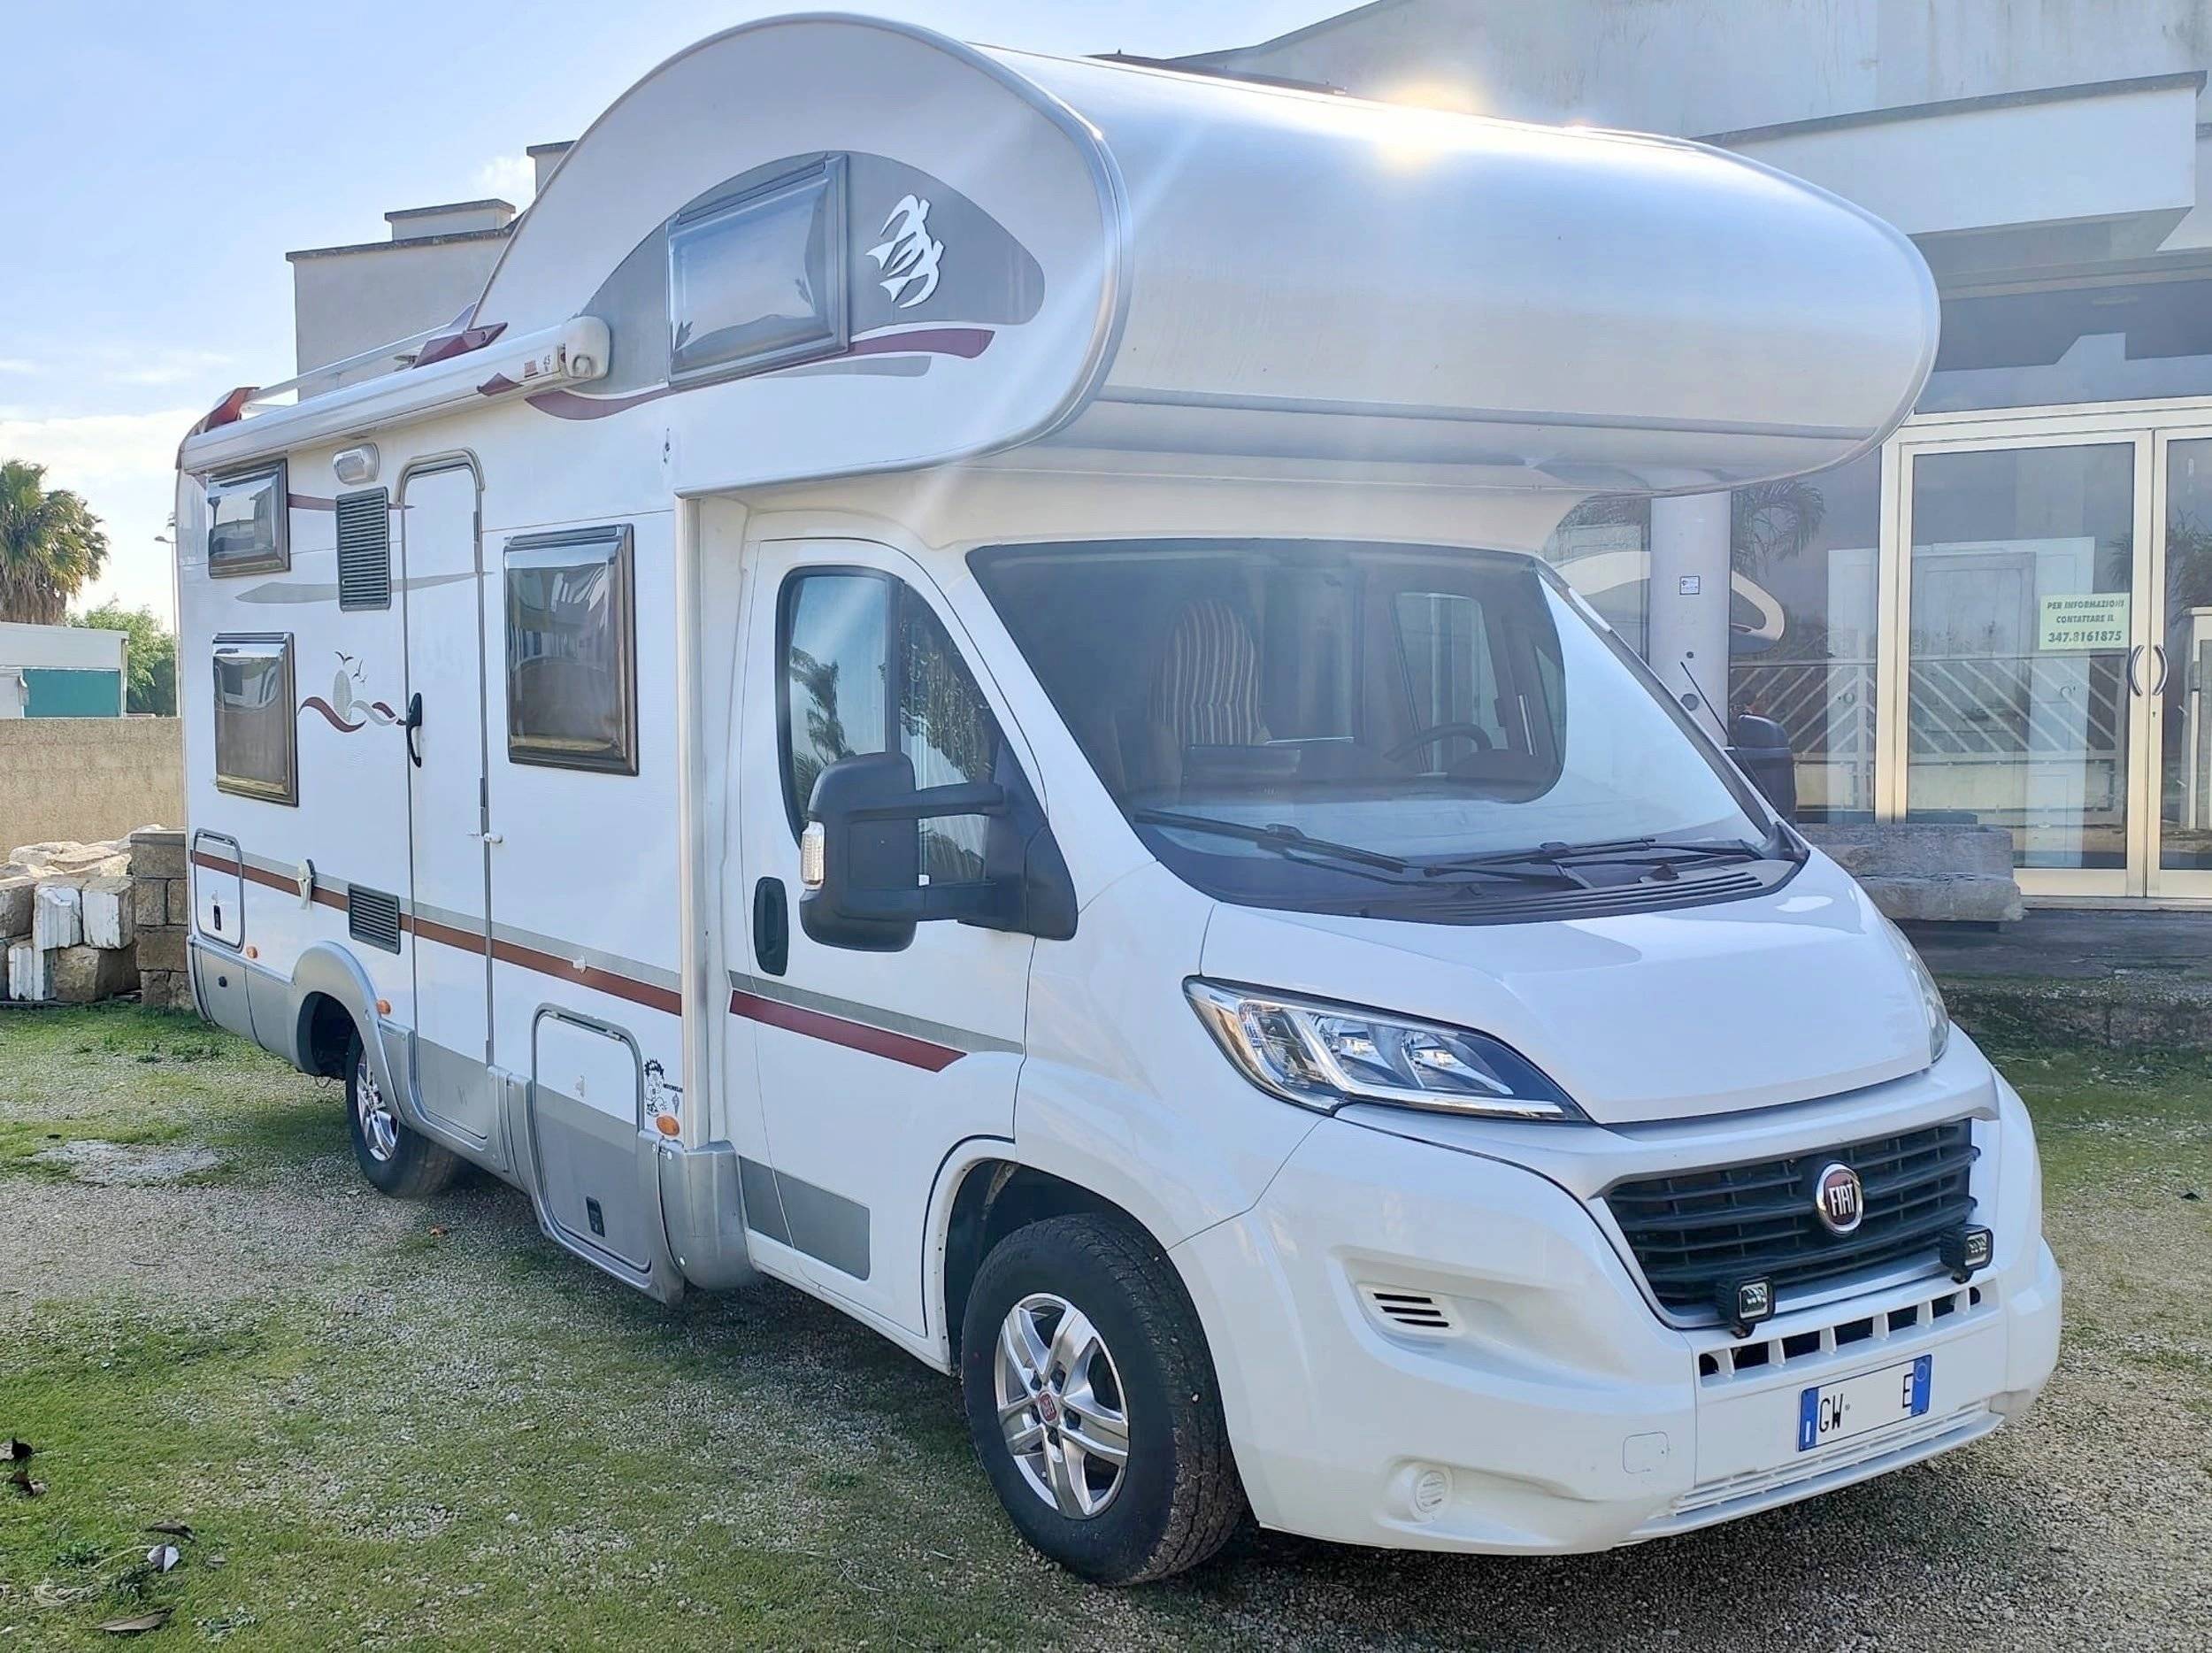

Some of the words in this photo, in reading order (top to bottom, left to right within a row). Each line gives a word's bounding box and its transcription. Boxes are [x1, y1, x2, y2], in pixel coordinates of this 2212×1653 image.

[2056, 615, 2105, 624] CONTATTARE
[1828, 1183, 1855, 1217] FIAT
[1819, 1393, 1844, 1433] GW
